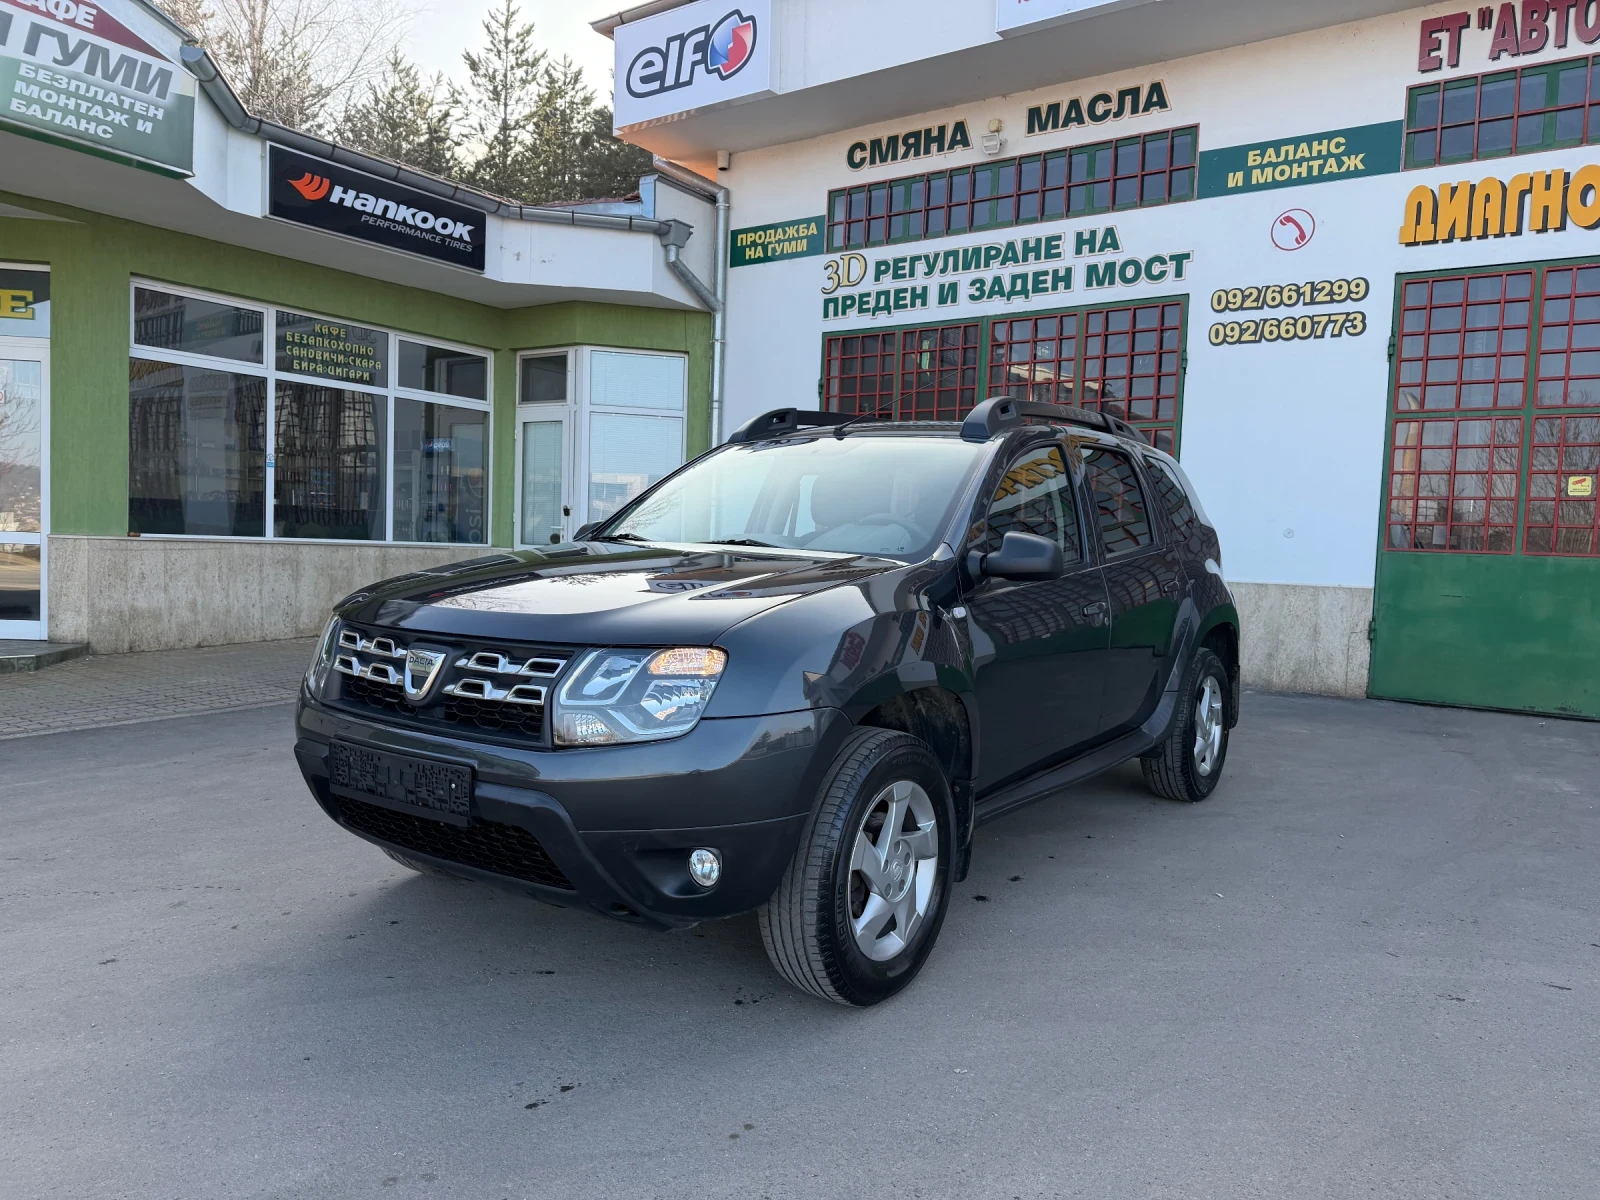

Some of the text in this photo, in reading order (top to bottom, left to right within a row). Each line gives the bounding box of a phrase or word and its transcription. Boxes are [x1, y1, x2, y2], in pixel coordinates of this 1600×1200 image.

[23, 21, 173, 100] ГУМИ
[1418, 11, 1470, 73] ЕТ
[626, 24, 710, 98] elf
[14, 80, 153, 135] МОНТАЖ И
[18, 63, 164, 120] БЕЗПЛАТЕН
[9, 97, 113, 139] БАЛАНС
[847, 80, 1171, 171] СМЯНА МАСЛА
[1227, 152, 1366, 188] И МОНТАЖ
[1247, 137, 1346, 167] БАЛАНС
[361, 214, 473, 252] PERFORMANCE TIRES
[737, 222, 818, 246] ПРОДАЖБА
[745, 238, 808, 260] НА ГУМИ
[821, 225, 1122, 294] 3D РЕГУЛИРАНЕ НА
[822, 250, 1194, 321] ПРЕДЕН И ЗАДЕН МОСТ
[1211, 277, 1369, 313] 092/661299
[314, 323, 347, 338] КАФЕ
[1208, 311, 1366, 346] 092/660773
[293, 359, 370, 381] БИРА ЦИГАРИ
[348, 356, 382, 370] СКАРА
[409, 656, 433, 666] DACIA
